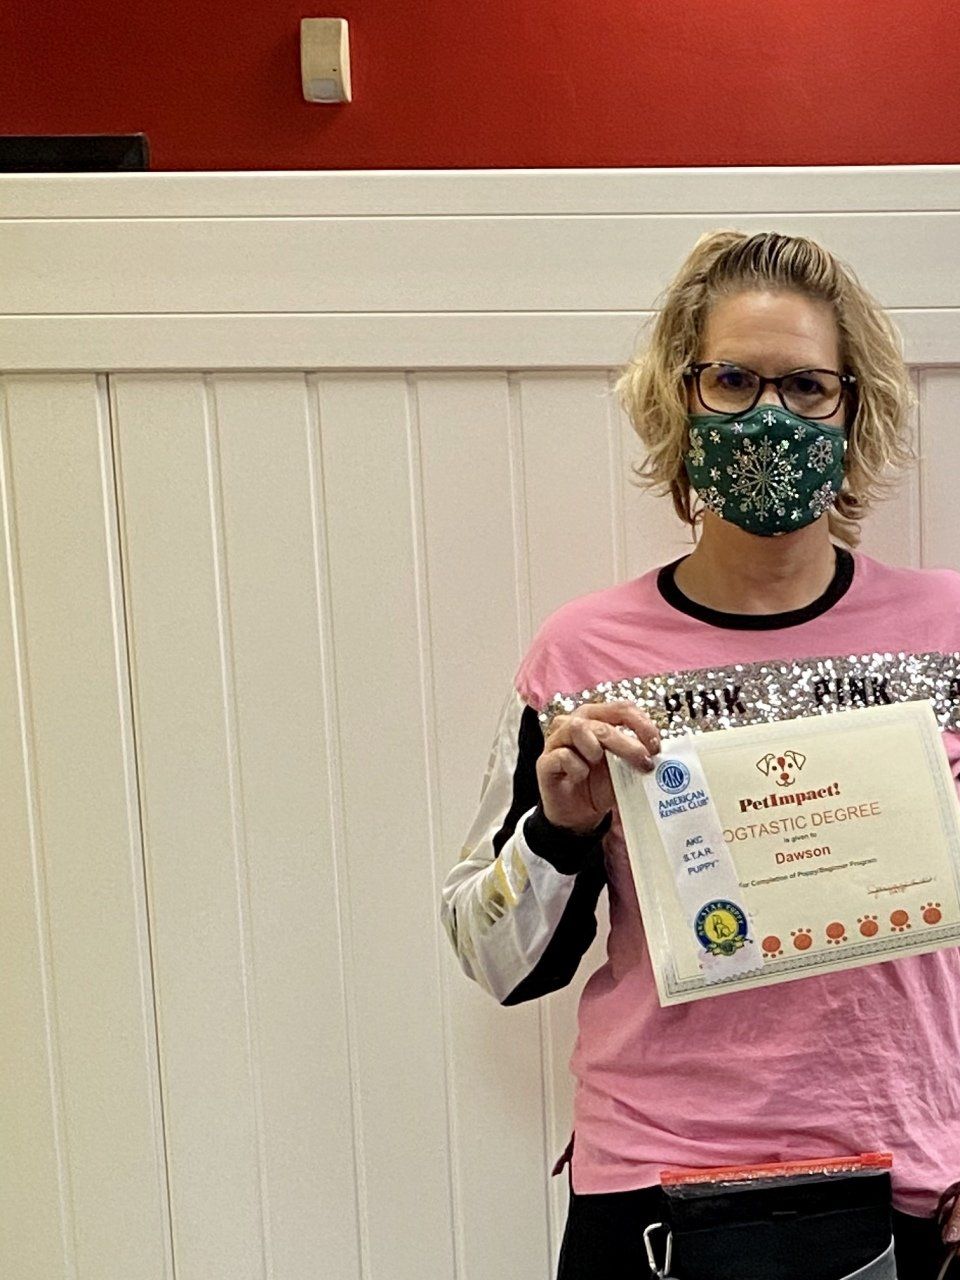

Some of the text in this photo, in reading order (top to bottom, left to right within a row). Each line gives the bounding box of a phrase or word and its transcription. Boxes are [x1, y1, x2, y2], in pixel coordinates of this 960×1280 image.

[665, 685, 746, 723] PINK
[814, 676, 891, 706] PINK
[658, 789, 706, 810] AMERICAN
[738, 782, 841, 813] PetImpact!
[659, 805, 688, 819] KENNEL
[722, 801, 882, 843] OGTASTIC DEGREE
[686, 835, 704, 847] AKC
[791, 834, 809, 843] given
[775, 845, 832, 865] Dawson
[687, 861, 716, 876] PUPPY
